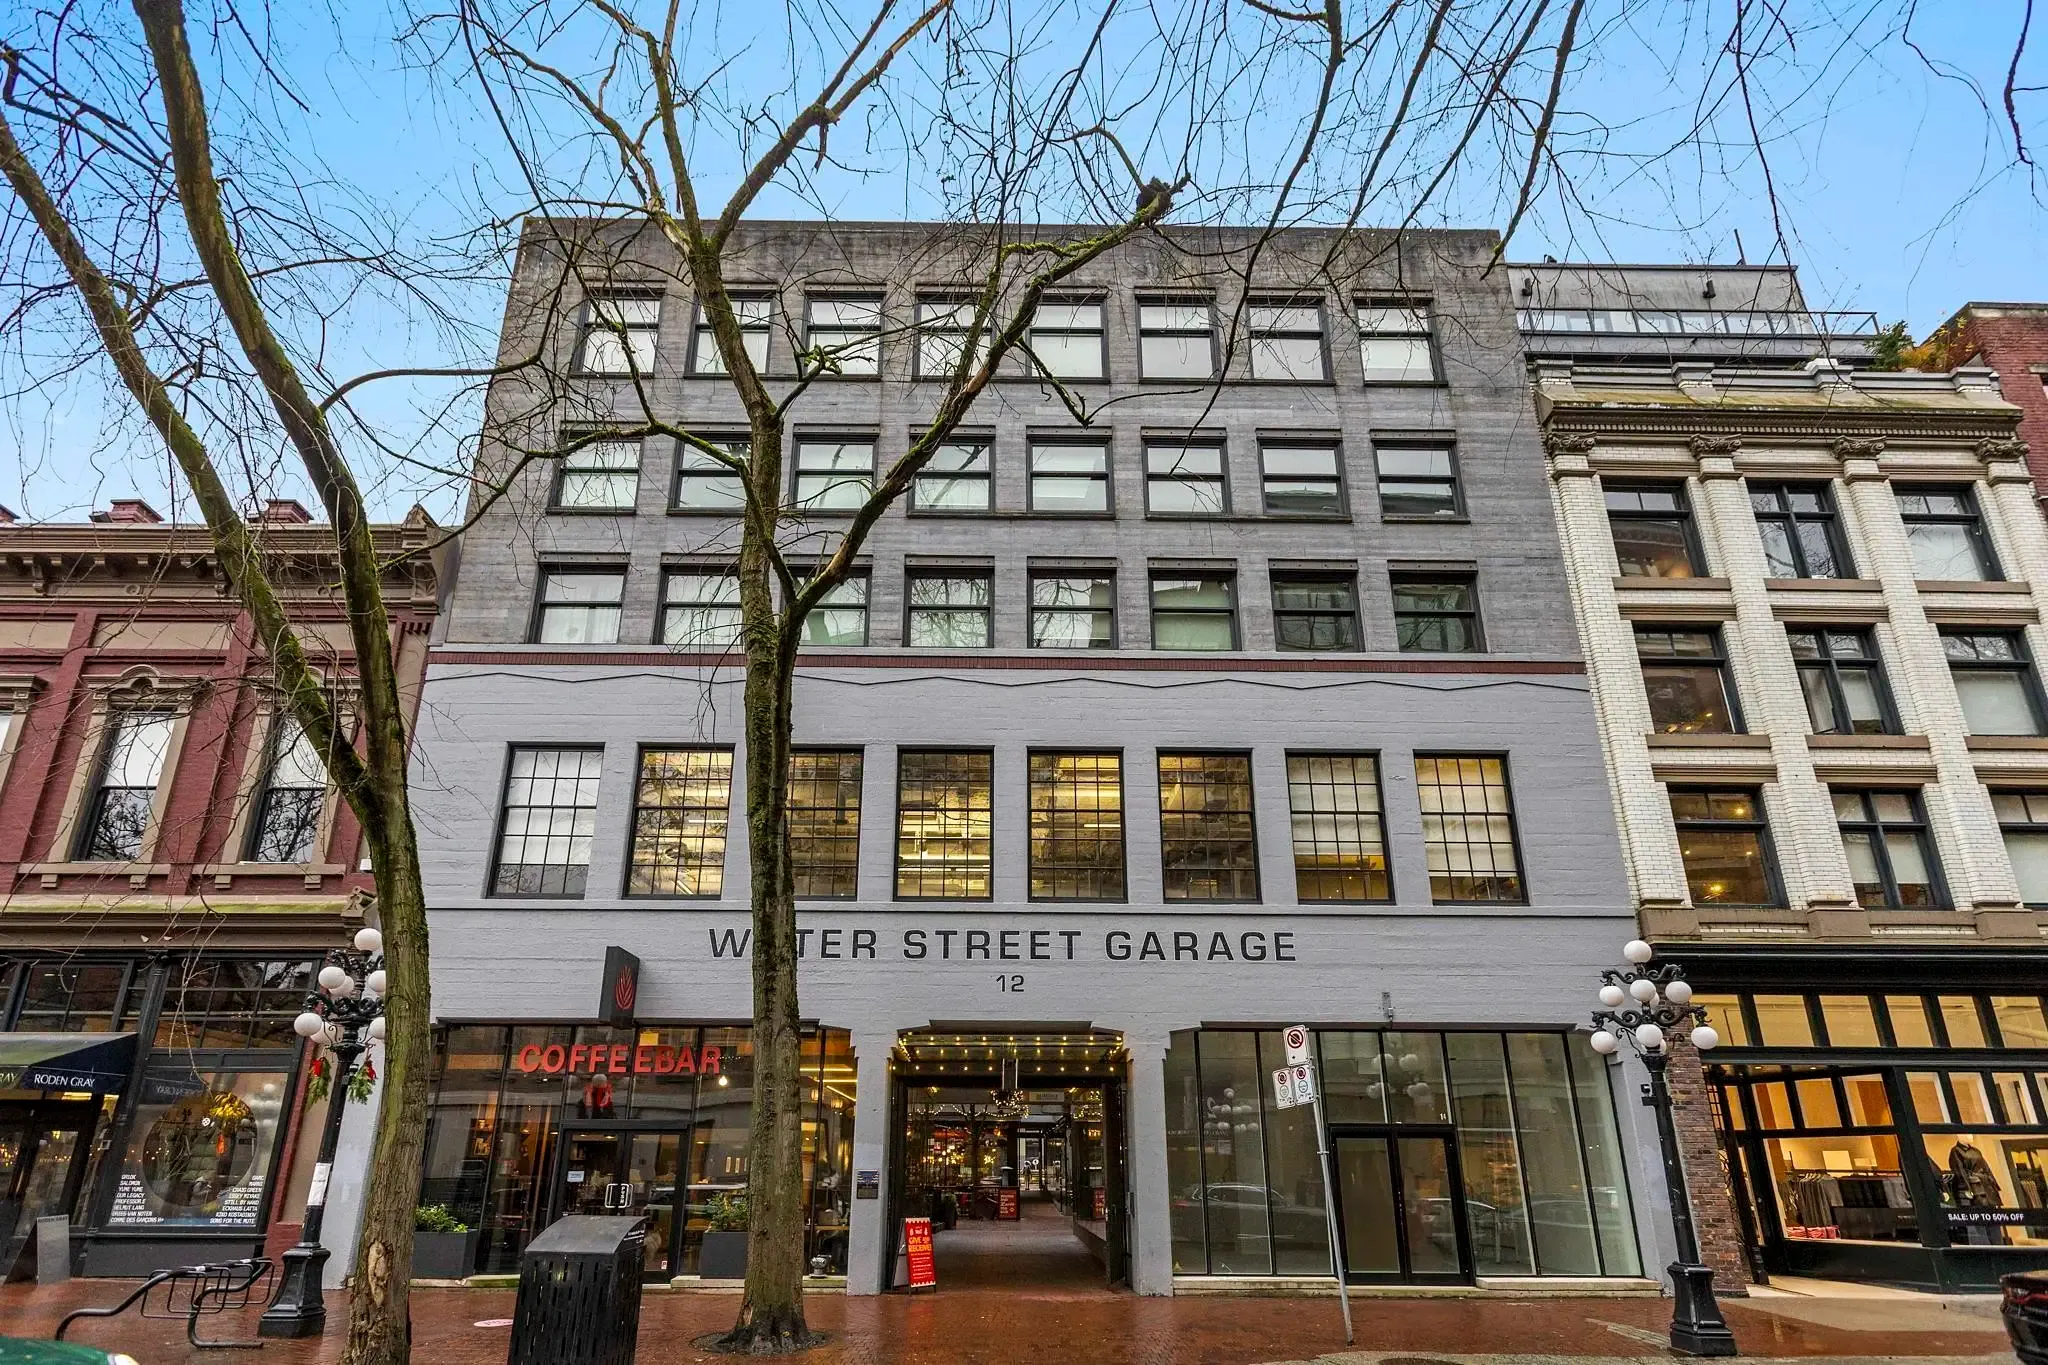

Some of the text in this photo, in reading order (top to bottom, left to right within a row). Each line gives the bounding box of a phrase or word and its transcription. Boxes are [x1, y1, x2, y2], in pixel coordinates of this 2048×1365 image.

[709, 929, 1297, 962] WTER STREET GARAGE
[996, 974, 1025, 993] 12
[519, 1043, 720, 1074] COFFEEBAR
[34, 1073, 95, 1088] RODEN GRAY
[1948, 1213, 1969, 1221] SALE:
[1969, 1213, 1980, 1221] UP
[1981, 1213, 1991, 1221] TO
[2010, 1213, 2025, 1222] OFF
